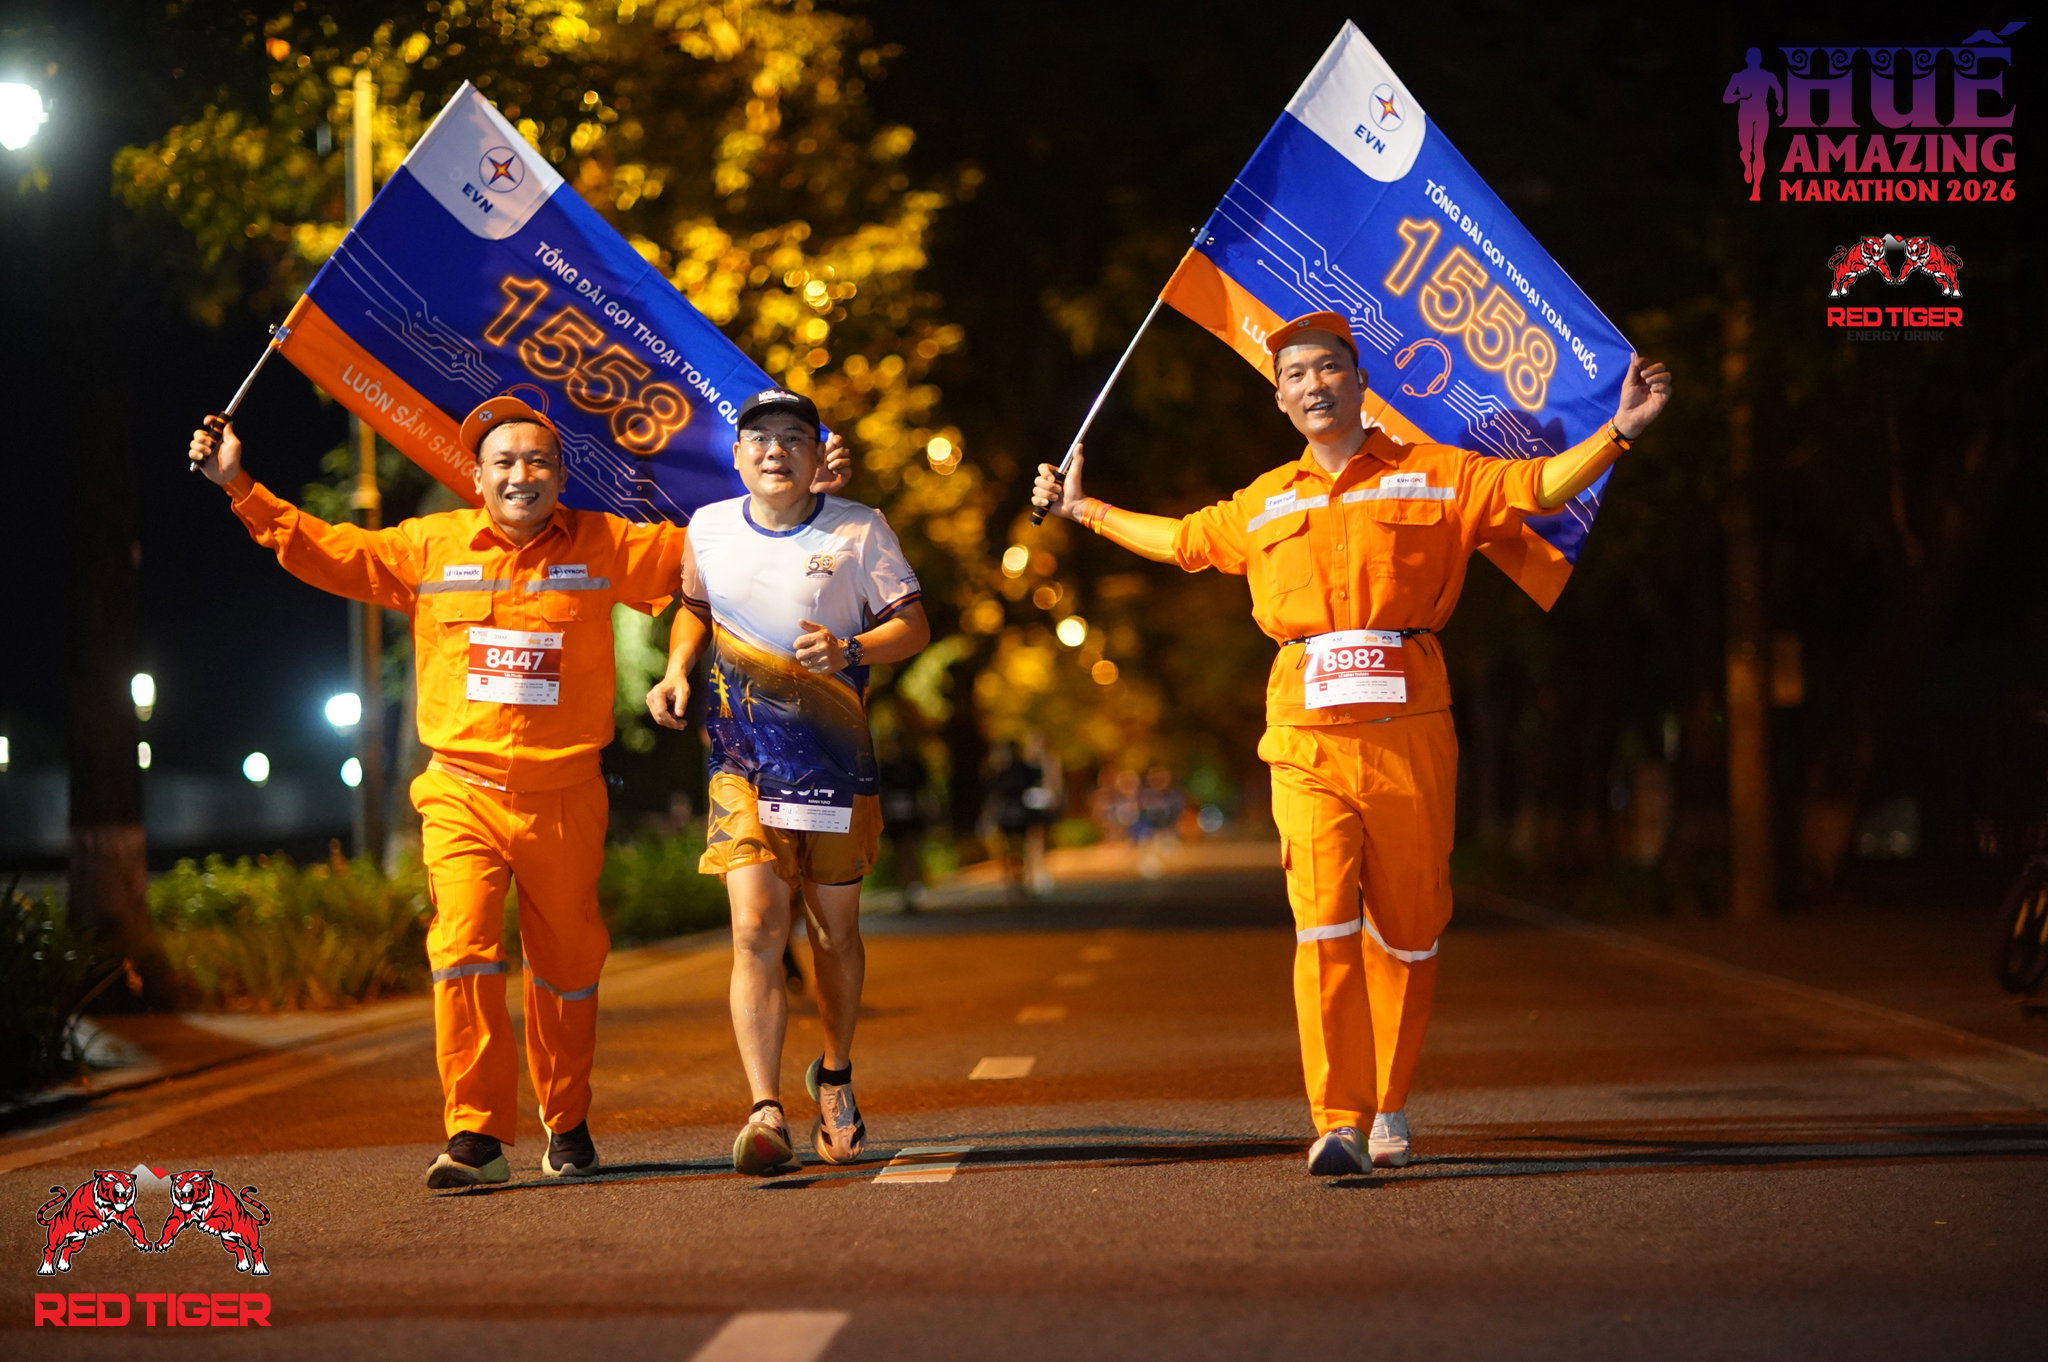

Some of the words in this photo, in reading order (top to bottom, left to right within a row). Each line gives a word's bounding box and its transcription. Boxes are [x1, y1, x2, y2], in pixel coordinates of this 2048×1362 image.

[1354, 124, 1386, 154] EVN
[462, 182, 494, 213] EVN
[1424, 179, 1461, 223] TỔNG
[1459, 214, 1483, 245] ĐÀI
[1482, 239, 1505, 269] GỌI
[1506, 261, 1541, 307] THOẠI
[1541, 299, 1572, 342] TOÀN
[1572, 336, 1598, 380] QUỐC
[1384, 218, 1557, 410] 1558
[484, 276, 692, 454] 1558
[576, 278, 606, 306] ĐÀI
[603, 301, 635, 329] GỌI
[633, 322, 682, 367] THOẠI
[680, 362, 720, 403] TOÀN
[718, 400, 738, 432] QU
[342, 364, 394, 413] LUÔN
[486, 647, 545, 671] 8447
[1322, 648, 1385, 672] 8982
